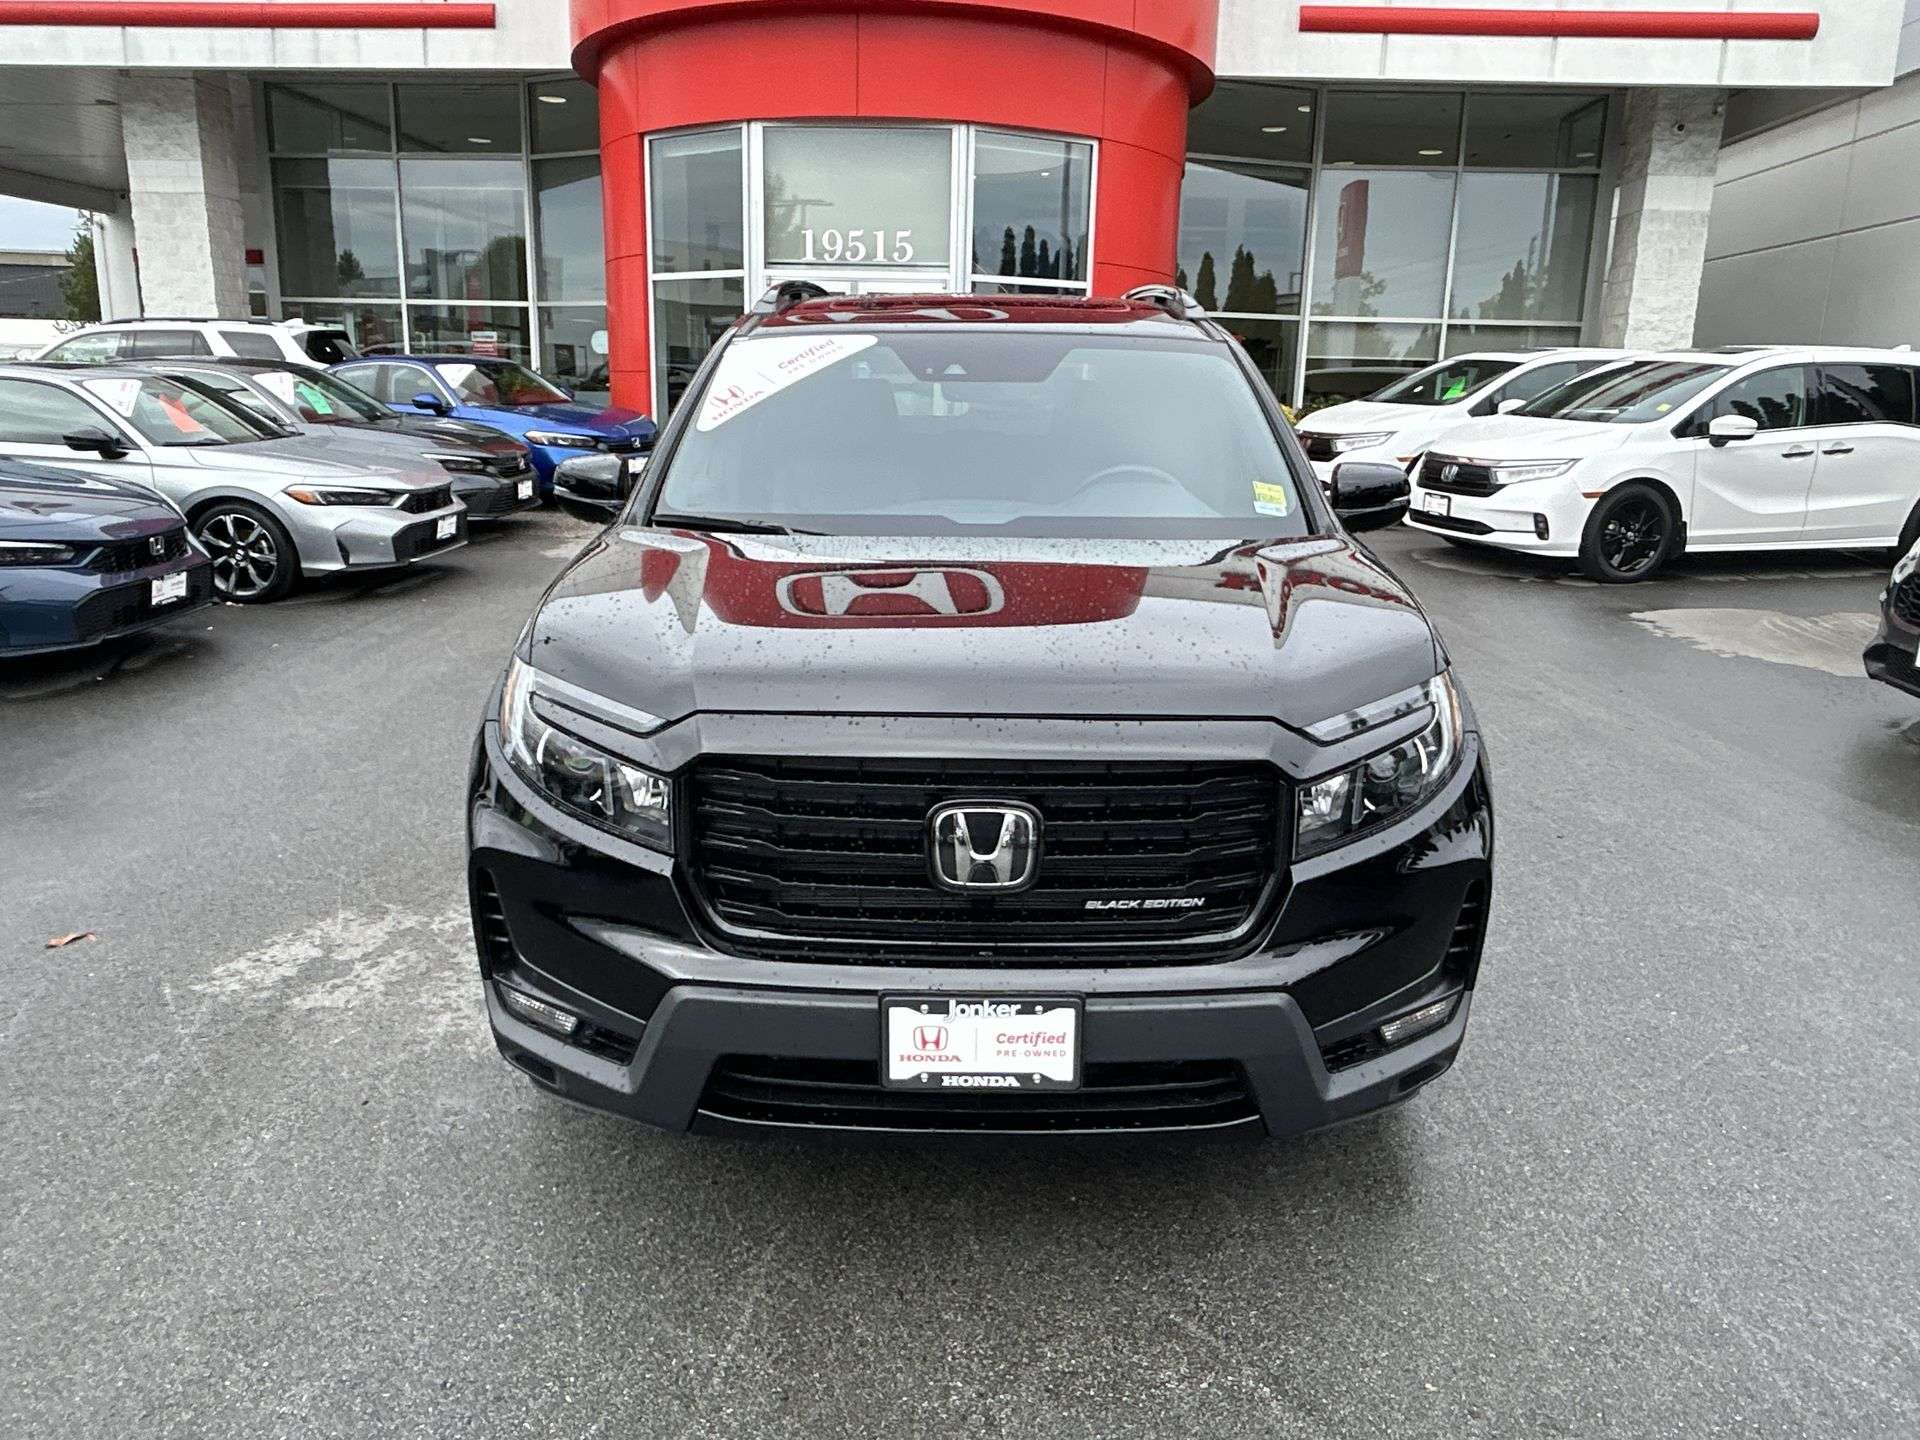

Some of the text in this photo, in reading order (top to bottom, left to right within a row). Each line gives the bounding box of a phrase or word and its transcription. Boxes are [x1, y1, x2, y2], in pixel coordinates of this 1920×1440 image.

[800, 229, 914, 262] 19515
[777, 339, 835, 369] Certified
[1084, 897, 1206, 909] BLACK EDITION
[943, 999, 1021, 1024] Jonker
[996, 1031, 1067, 1048] Certified
[899, 1053, 962, 1063] HONDA
[996, 1049, 1067, 1058] PRE-OWNED
[941, 1075, 1021, 1088] HONDA
